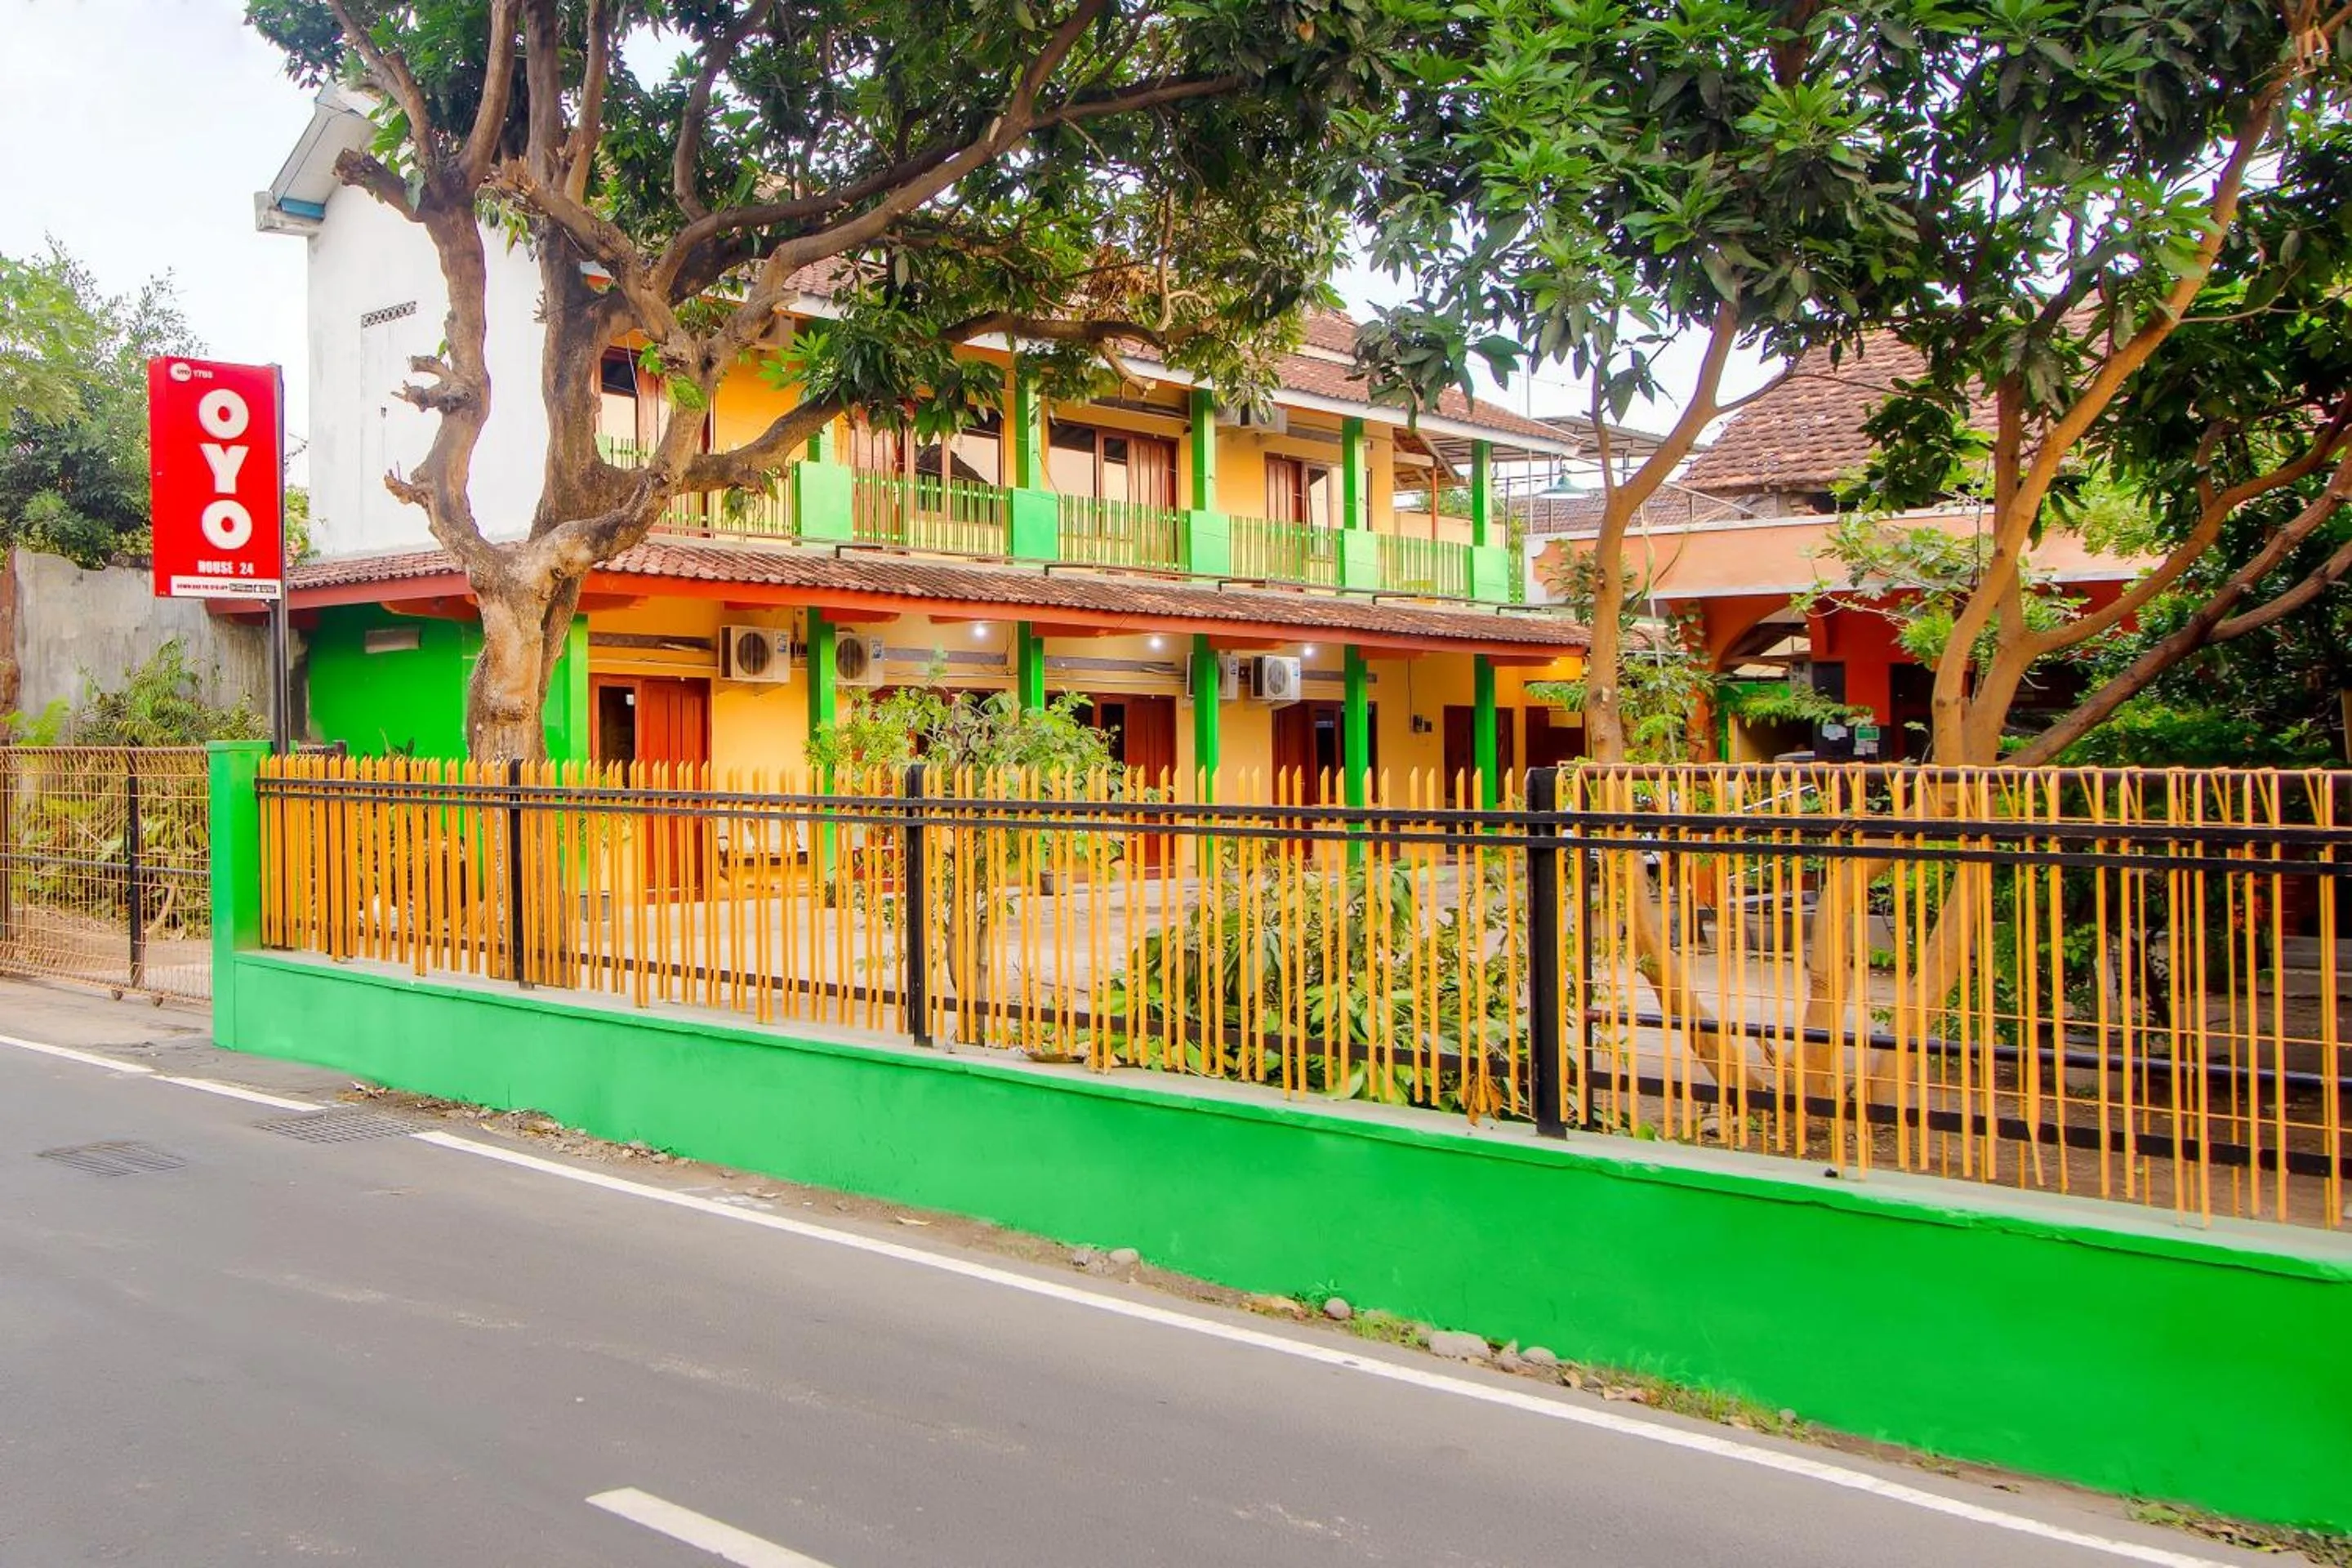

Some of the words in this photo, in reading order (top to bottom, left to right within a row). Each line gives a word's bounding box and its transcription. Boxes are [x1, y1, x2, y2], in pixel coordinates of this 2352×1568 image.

[198, 388, 252, 550] OYO
[198, 560, 234, 575] HOUSE
[239, 562, 255, 576] 24
